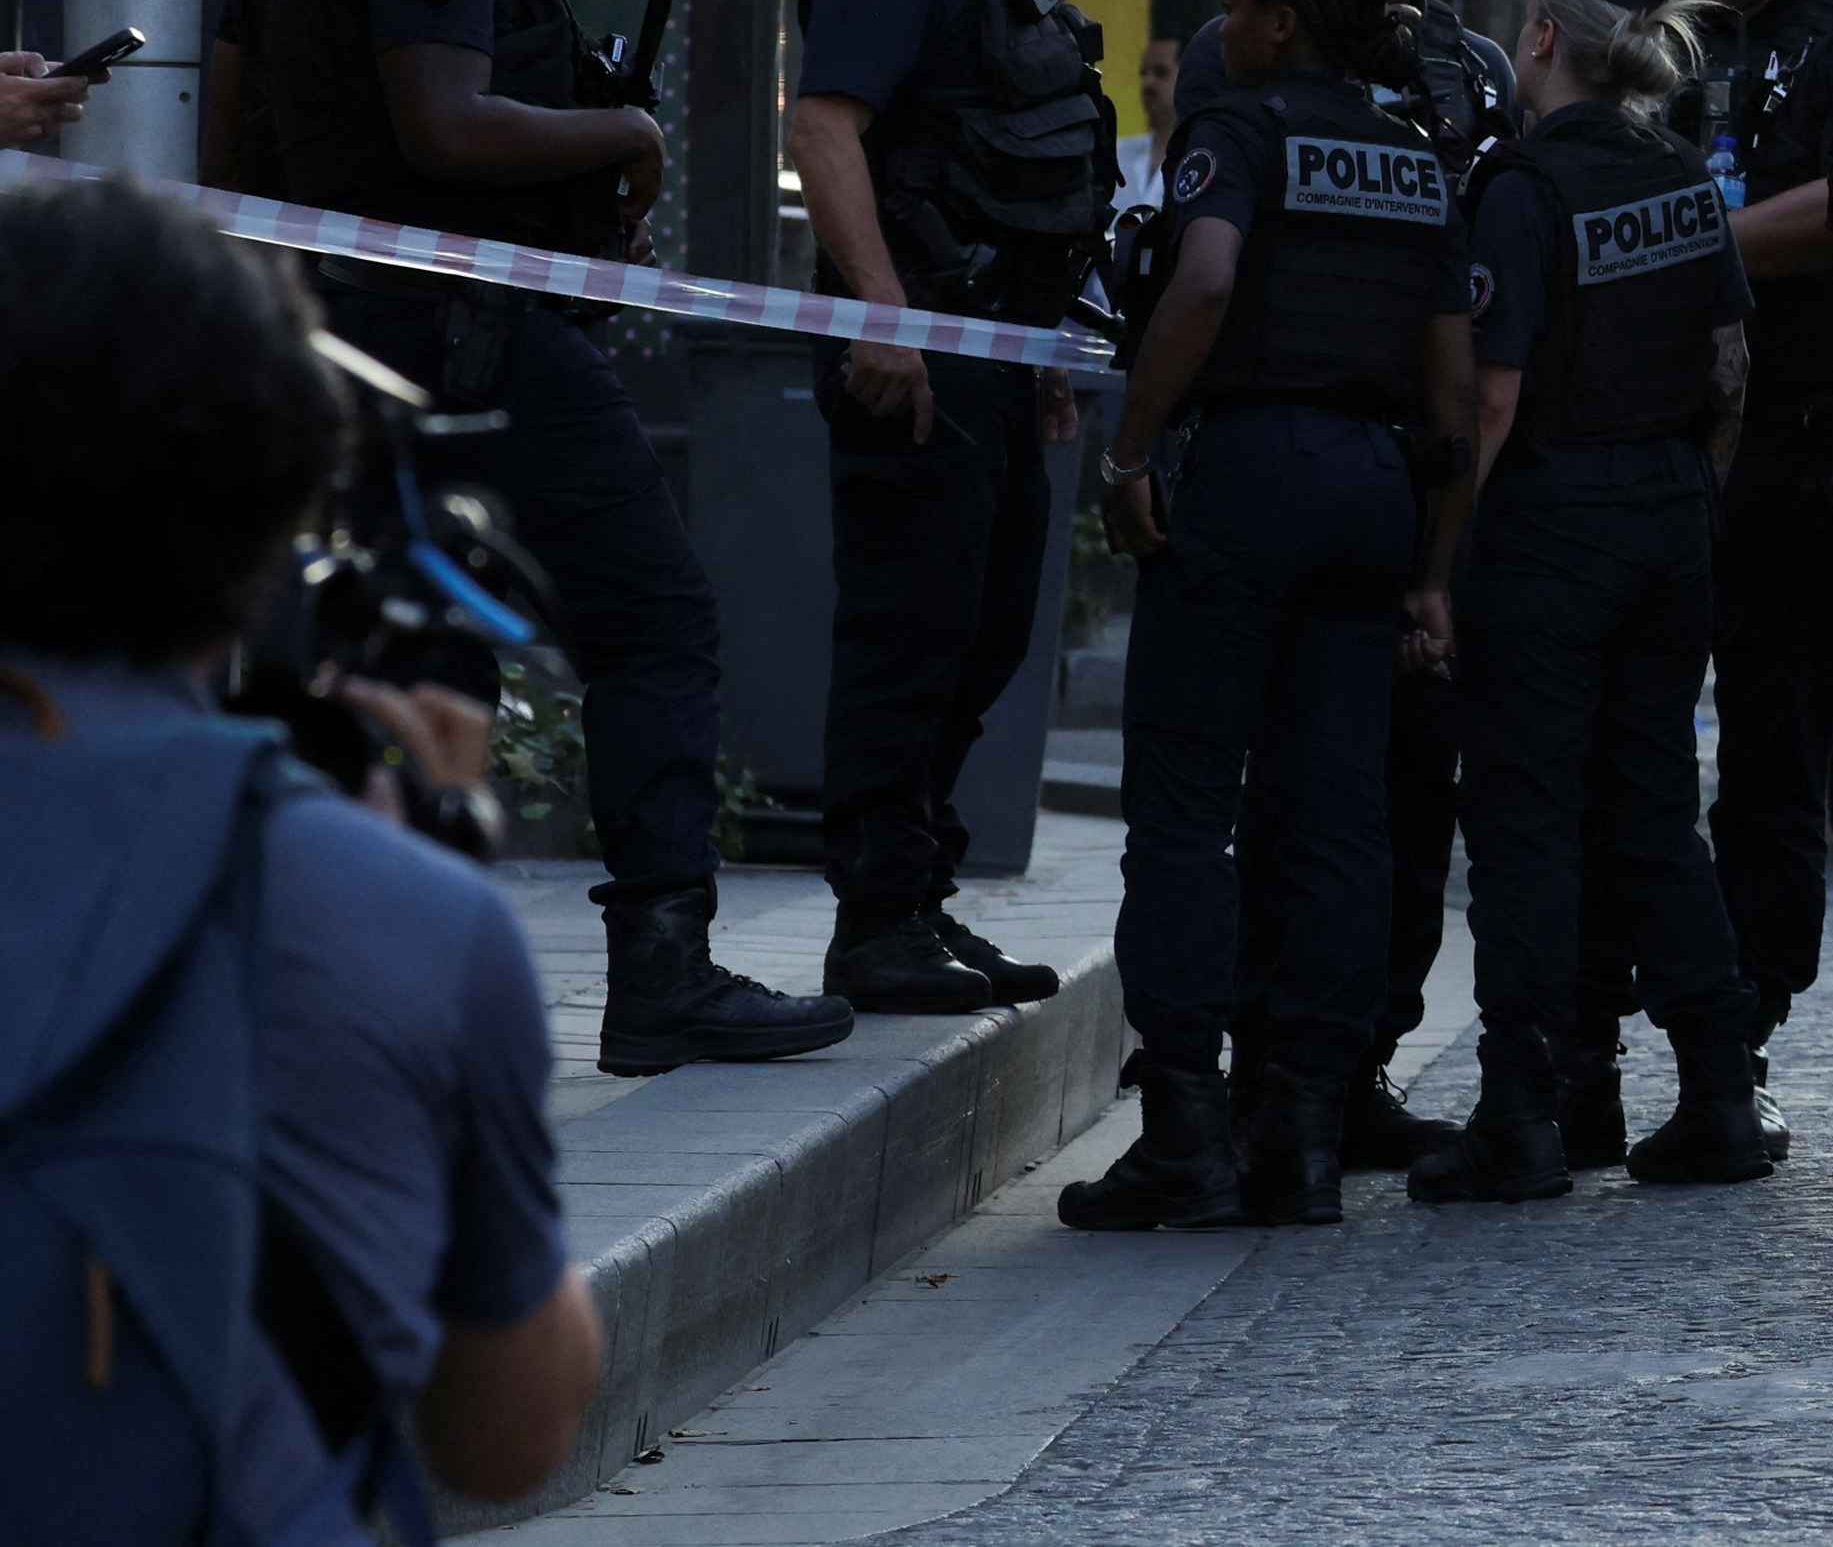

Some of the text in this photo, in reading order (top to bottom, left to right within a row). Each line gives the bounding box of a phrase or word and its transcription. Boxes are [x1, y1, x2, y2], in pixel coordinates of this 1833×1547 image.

[1298, 144, 1441, 201] POLICE
[1296, 191, 1441, 217] COMPAGNIE D'INTERVENTION
[1585, 190, 1719, 261] POLICE
[1588, 253, 1649, 277] COMPAGNIE
